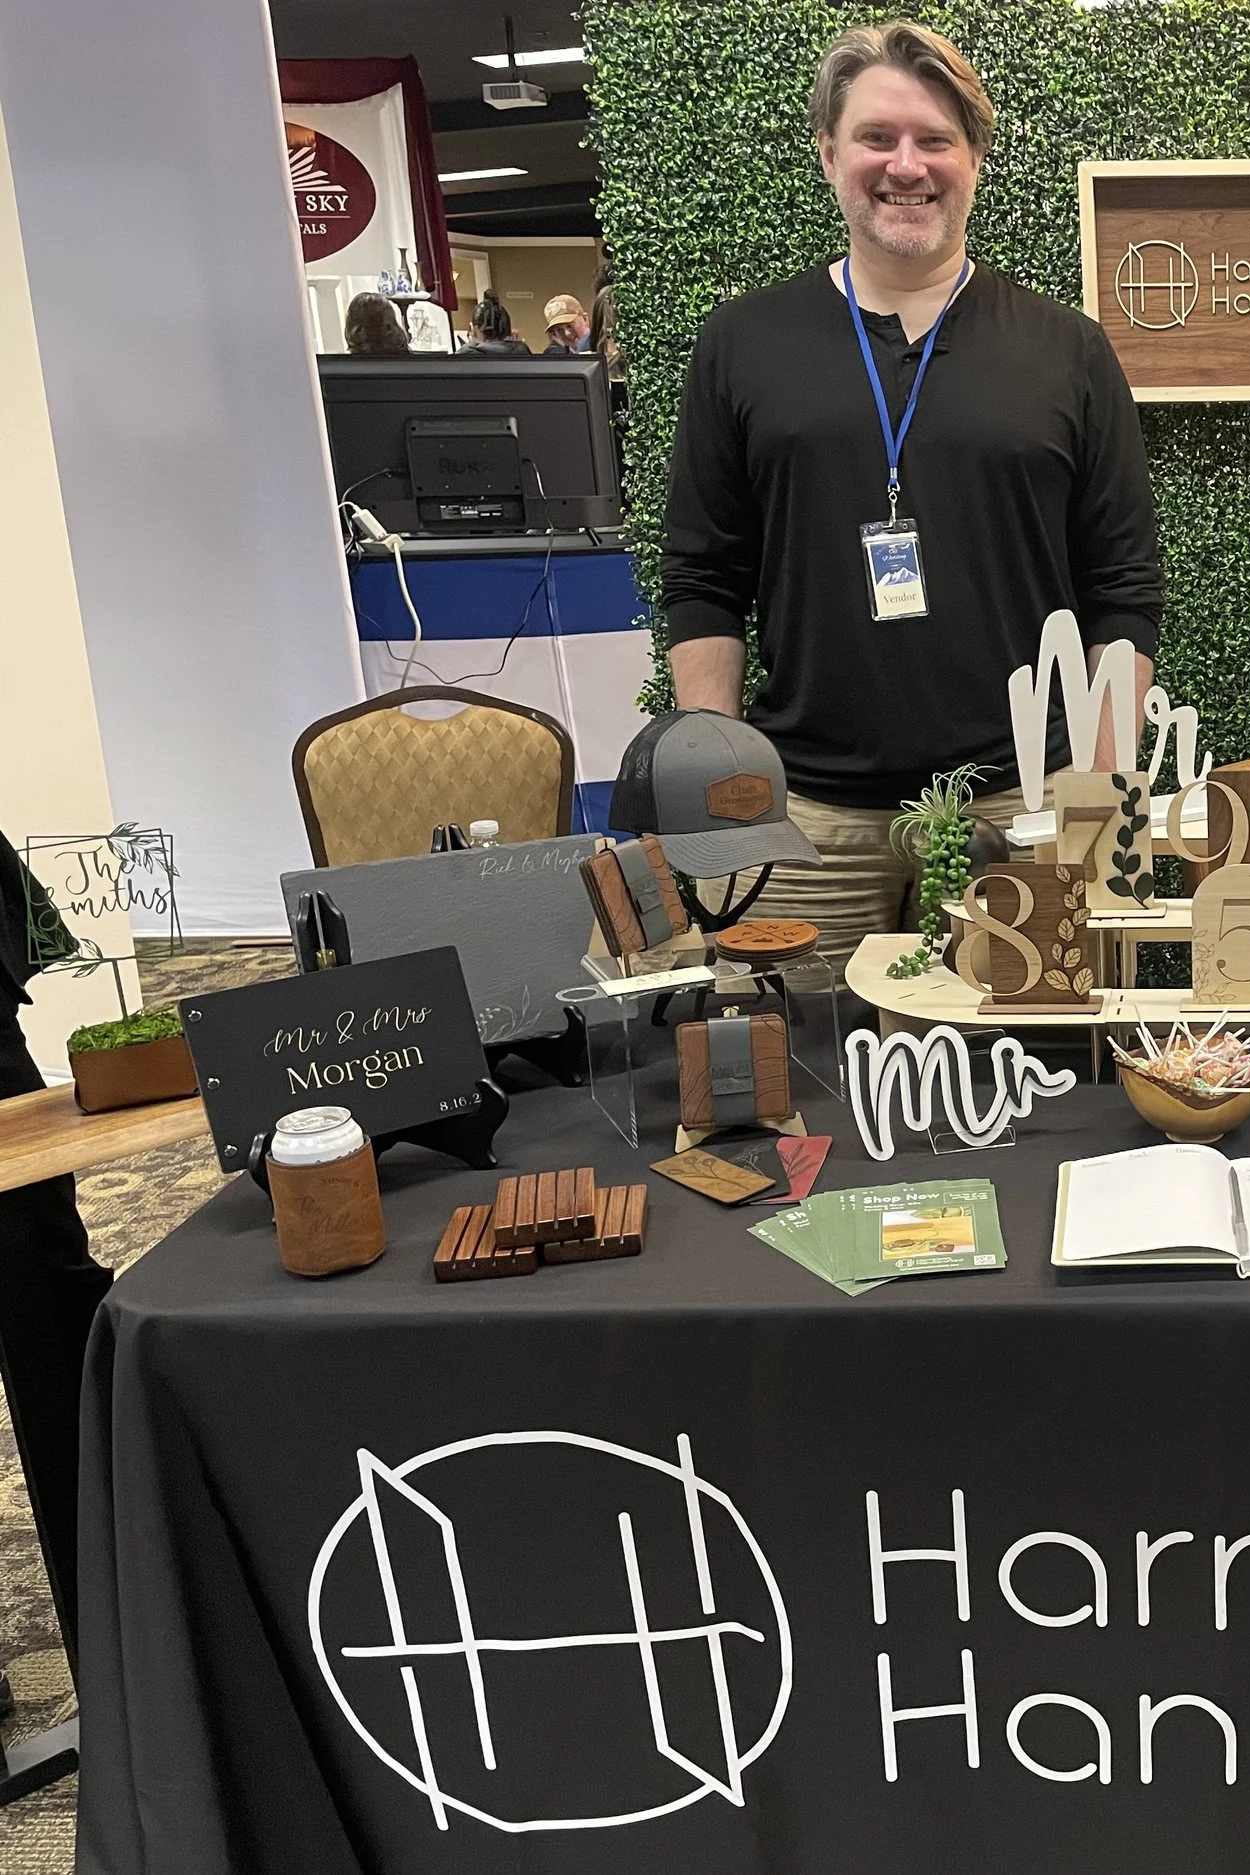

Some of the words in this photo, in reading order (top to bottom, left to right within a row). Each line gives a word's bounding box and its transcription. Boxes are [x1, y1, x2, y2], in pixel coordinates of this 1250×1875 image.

[305, 194, 349, 212] SKY
[883, 592, 917, 604] Vendor
[1008, 609, 1213, 812] Mr
[1064, 806, 1117, 883] 7
[1166, 780, 1249, 867] 9
[54, 846, 135, 896] The
[480, 857, 516, 880] Rick
[29, 878, 173, 932] Smiths
[955, 874, 1043, 997] 8
[263, 1027, 328, 1057] Mr
[336, 1010, 355, 1045] &
[363, 1005, 433, 1036] Mrs
[286, 1045, 425, 1096] Morgan
[845, 1025, 1077, 1162] Mr
[439, 1092, 482, 1112] 8.16.2
[863, 1195, 902, 1205] Shop
[906, 1193, 941, 1202] Now
